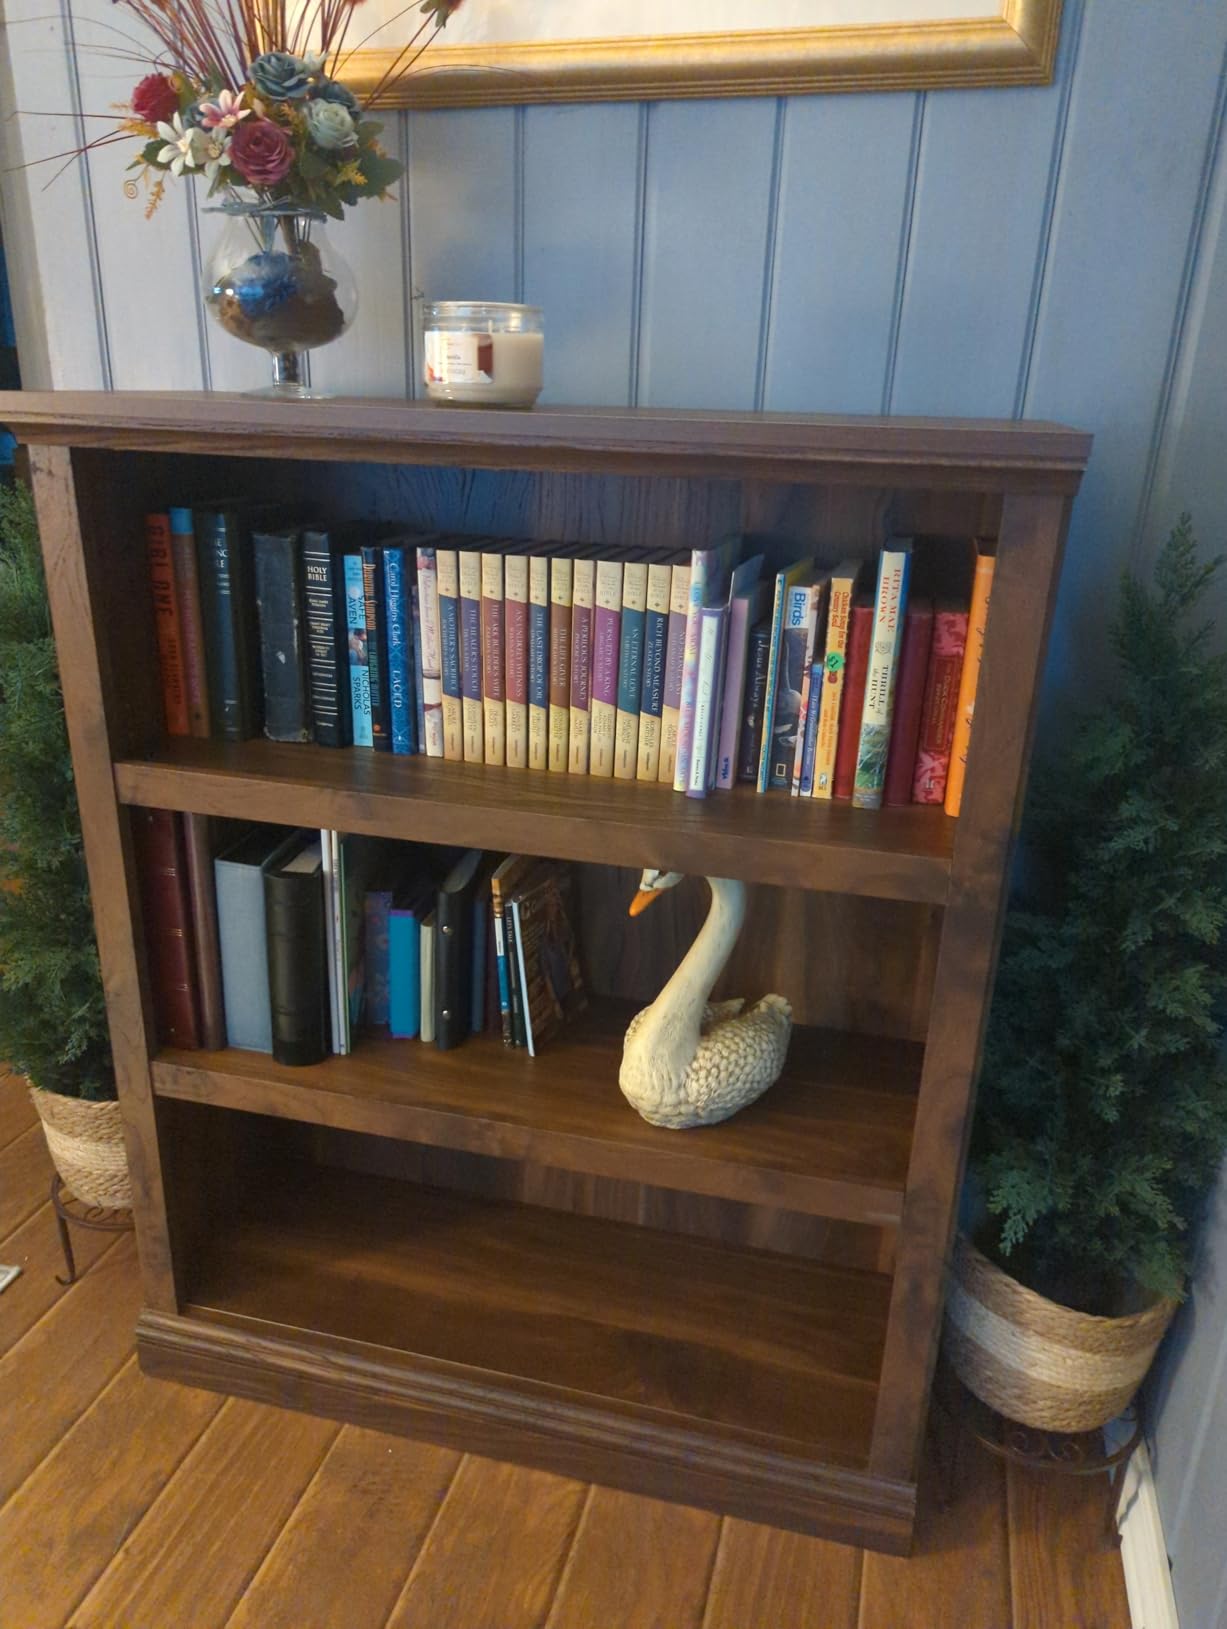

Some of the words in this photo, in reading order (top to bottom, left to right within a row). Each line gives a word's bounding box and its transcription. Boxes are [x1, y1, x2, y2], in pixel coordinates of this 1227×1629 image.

[307, 565, 327, 574] HOLY
[308, 573, 328, 582] BIBLE
[390, 562, 400, 587] Carol
[891, 569, 901, 600] RITA
[348, 594, 358, 625] AVEN
[358, 595, 366, 620] SAFE
[390, 590, 400, 622] Higgins
[792, 592, 807, 625] Birds
[880, 576, 890, 623] BROWN
[516, 609, 523, 621] AN
[656, 617, 664, 637] RICH
[887, 606, 897, 632] MAE
[392, 624, 401, 647] Clark
[559, 628, 567, 642] THE
[632, 628, 639, 639] AN
[559, 645, 567, 661] LIFE
[654, 639, 663, 673] BEYOND
[757, 640, 769, 668] Jesus
[449, 654, 457, 690] SACRIFICE
[559, 663, 567, 687] GIVER
[580, 665, 588, 700] JOURNEY
[603, 676, 611, 697] KING
[878, 665, 889, 706] THRILL
[352, 676, 361, 710] SPARKS
[361, 669, 371, 715] NICHOLAS
[392, 670, 403, 708] LACED
[651, 674, 660, 713] MEASURE
[751, 671, 766, 708] Always
[869, 680, 878, 709] HUNT
